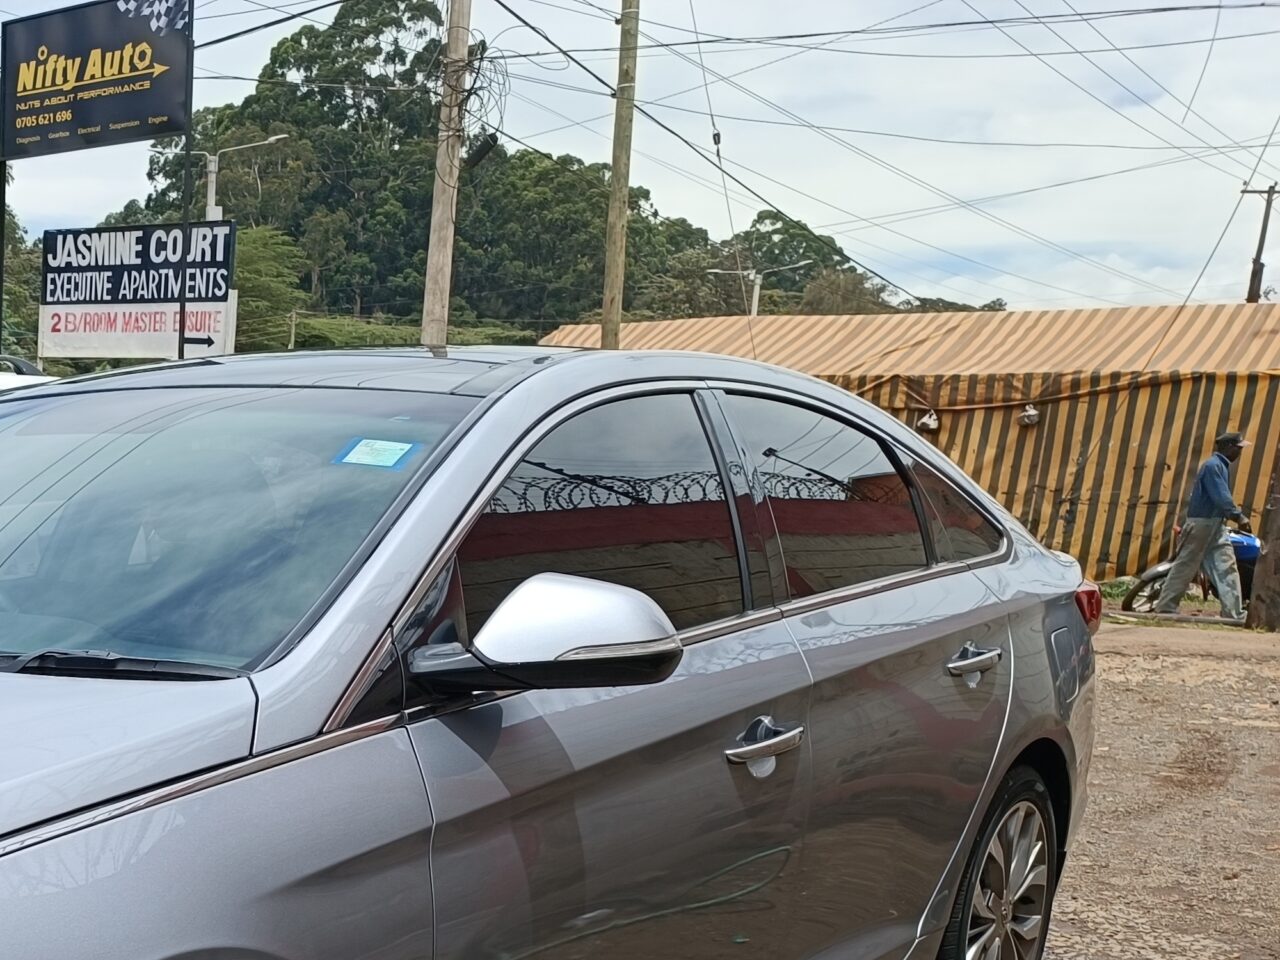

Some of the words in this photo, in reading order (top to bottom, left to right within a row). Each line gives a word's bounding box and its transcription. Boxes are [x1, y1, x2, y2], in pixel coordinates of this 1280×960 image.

[17, 45, 81, 91] Nifty
[84, 42, 152, 80] Auto
[16, 100, 41, 111] NUTS
[43, 93, 75, 106] ABOUT
[77, 80, 151, 100] PERFORMANCE
[16, 115, 37, 128] 0705
[38, 112, 54, 125] 621
[56, 109, 72, 122] 696
[47, 230, 143, 268] JASMINE
[46, 271, 112, 302] EXECUTIVE
[50, 312, 62, 333] 2
[64, 311, 118, 333] B/ROOM
[121, 311, 167, 333] MASTER
